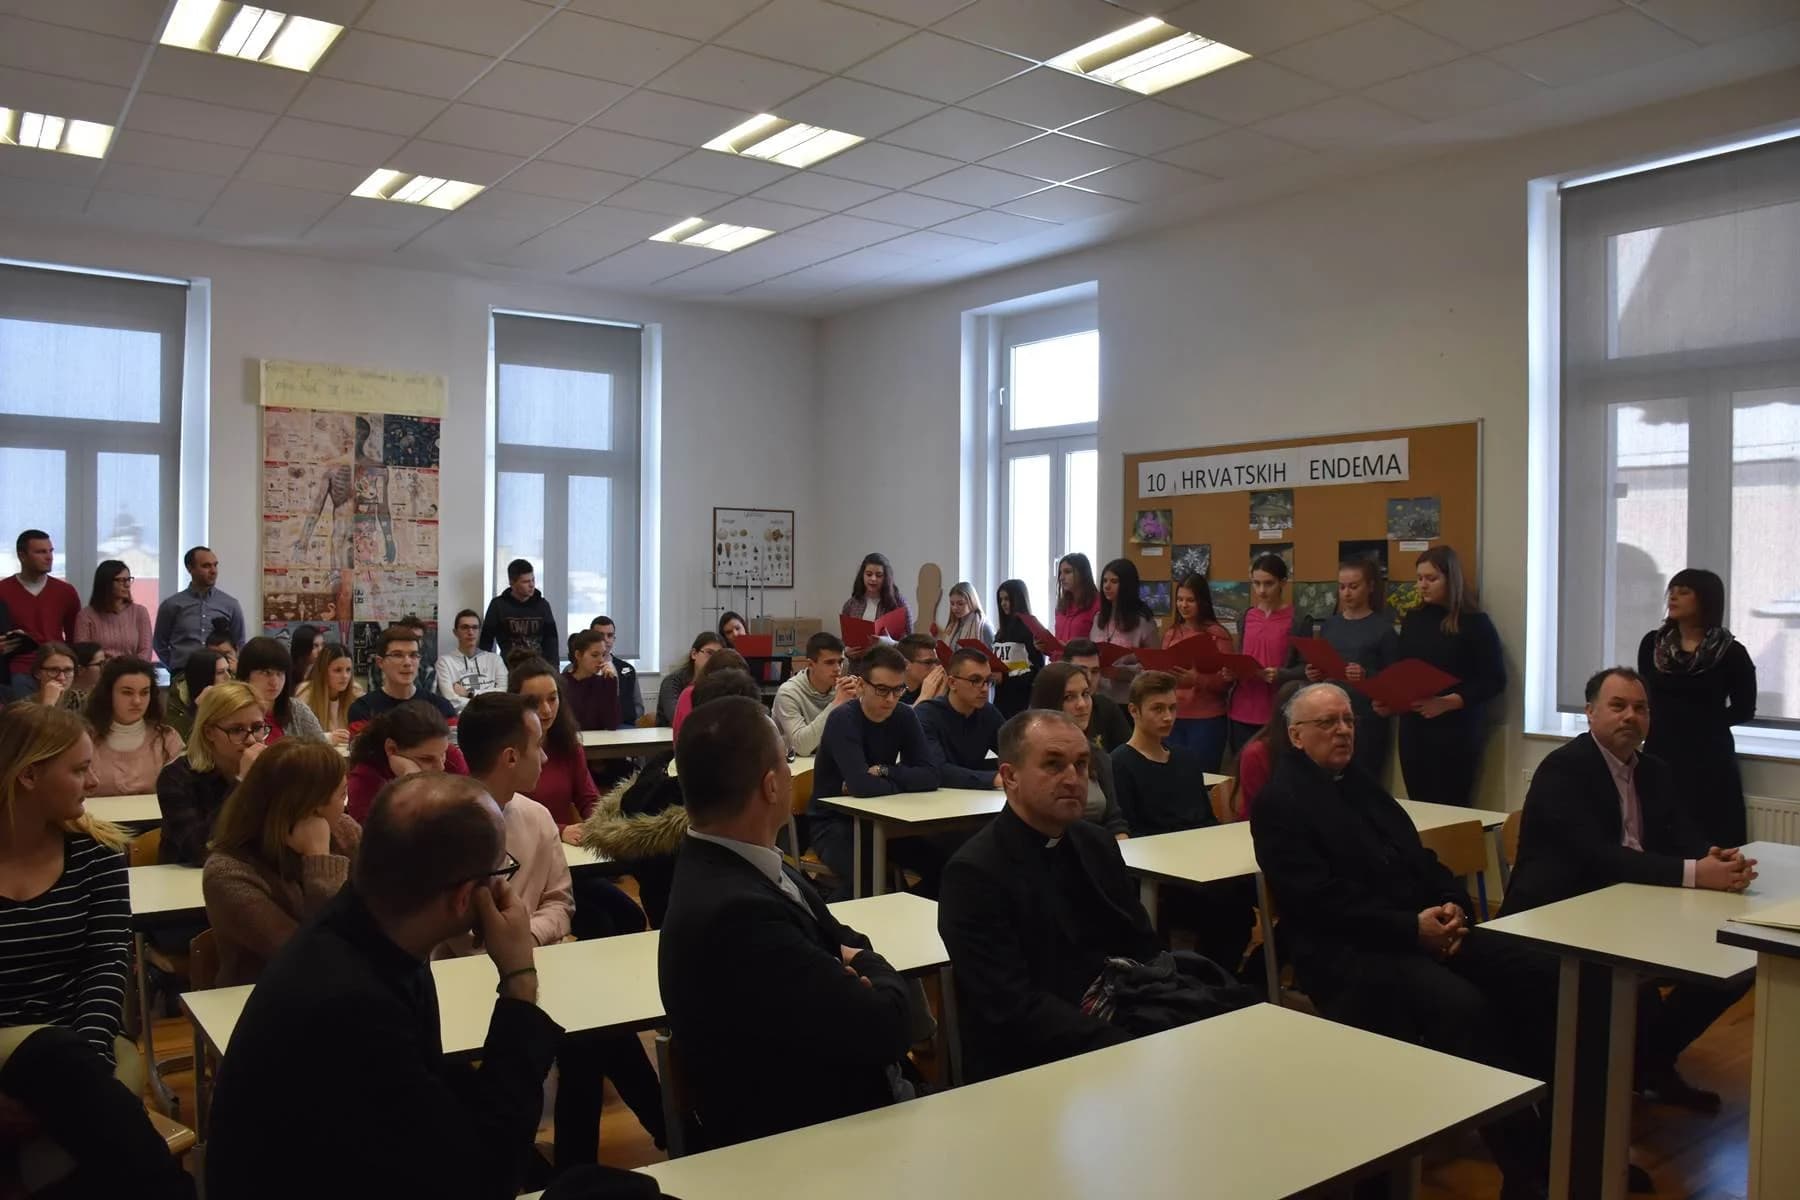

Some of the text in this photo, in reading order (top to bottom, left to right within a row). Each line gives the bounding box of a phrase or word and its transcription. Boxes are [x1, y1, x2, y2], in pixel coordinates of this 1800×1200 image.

[1147, 454, 1402, 492] 10 HRVATSKIH ENDEMA
